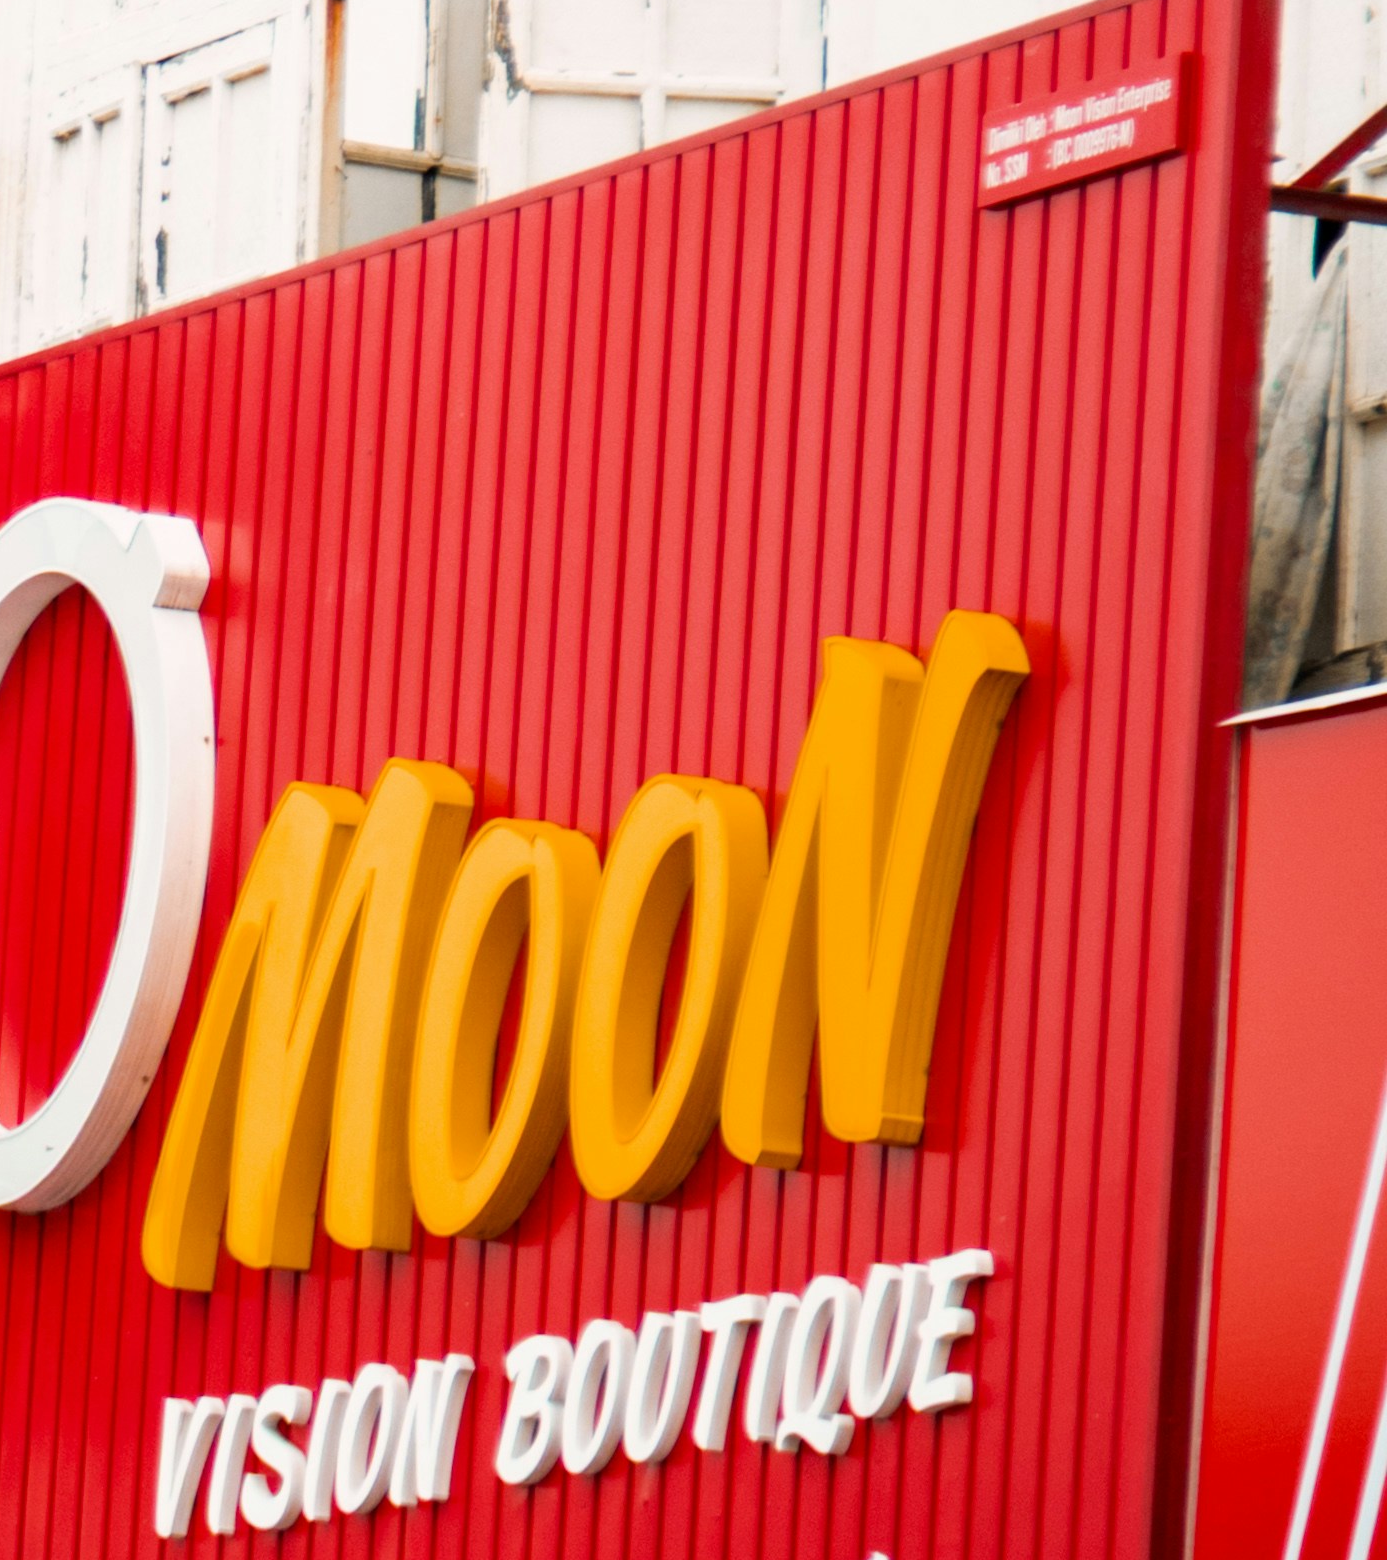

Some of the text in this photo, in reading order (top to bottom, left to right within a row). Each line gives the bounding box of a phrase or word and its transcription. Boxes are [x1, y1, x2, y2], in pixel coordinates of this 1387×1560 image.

[141, 608, 1031, 1293] MOON
[154, 1247, 995, 1539] VISION BOUTIQUE
